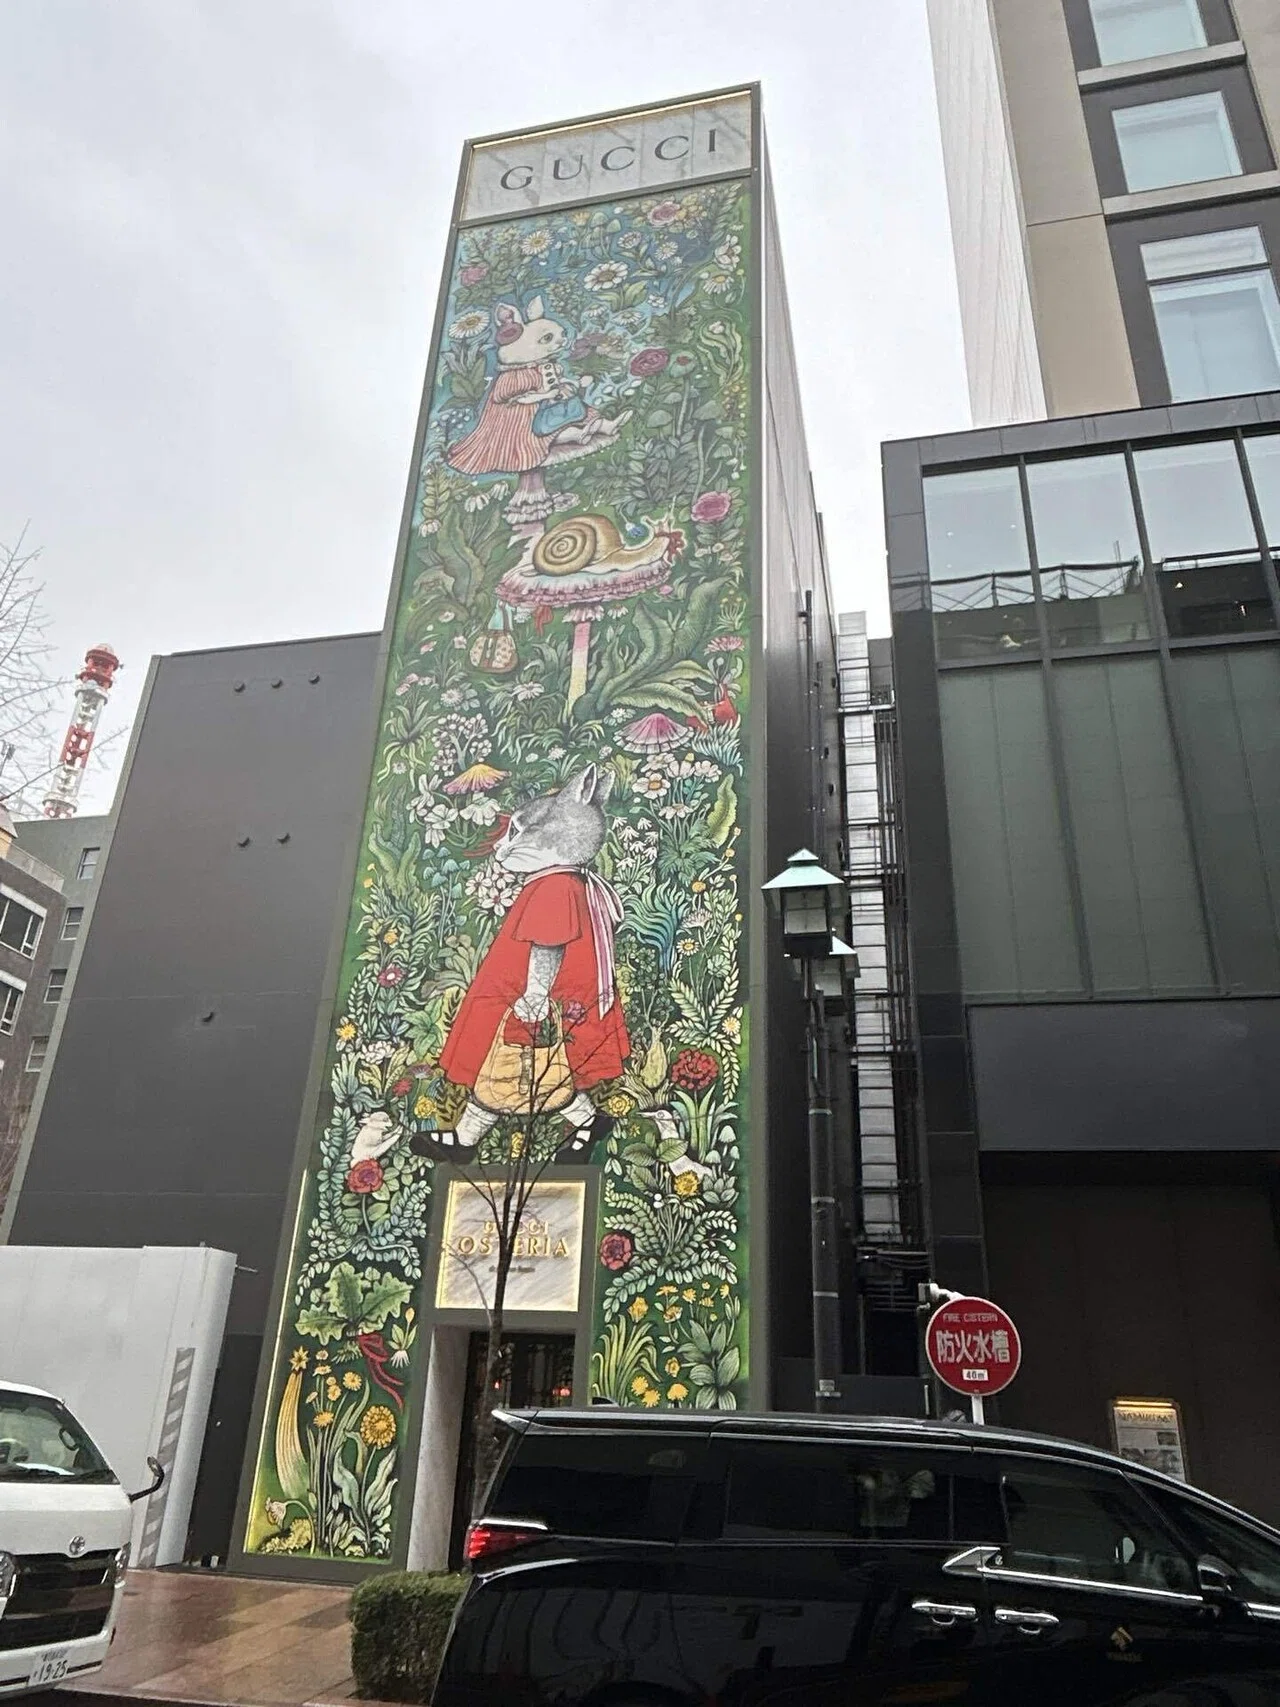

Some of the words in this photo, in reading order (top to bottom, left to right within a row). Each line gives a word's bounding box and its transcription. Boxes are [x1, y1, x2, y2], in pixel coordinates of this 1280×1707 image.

[500, 128, 716, 190] GUCCI
[484, 1220, 549, 1235] GCCI
[458, 1235, 569, 1257] OSERIA
[936, 1329, 1011, 1363] 防火水槽
